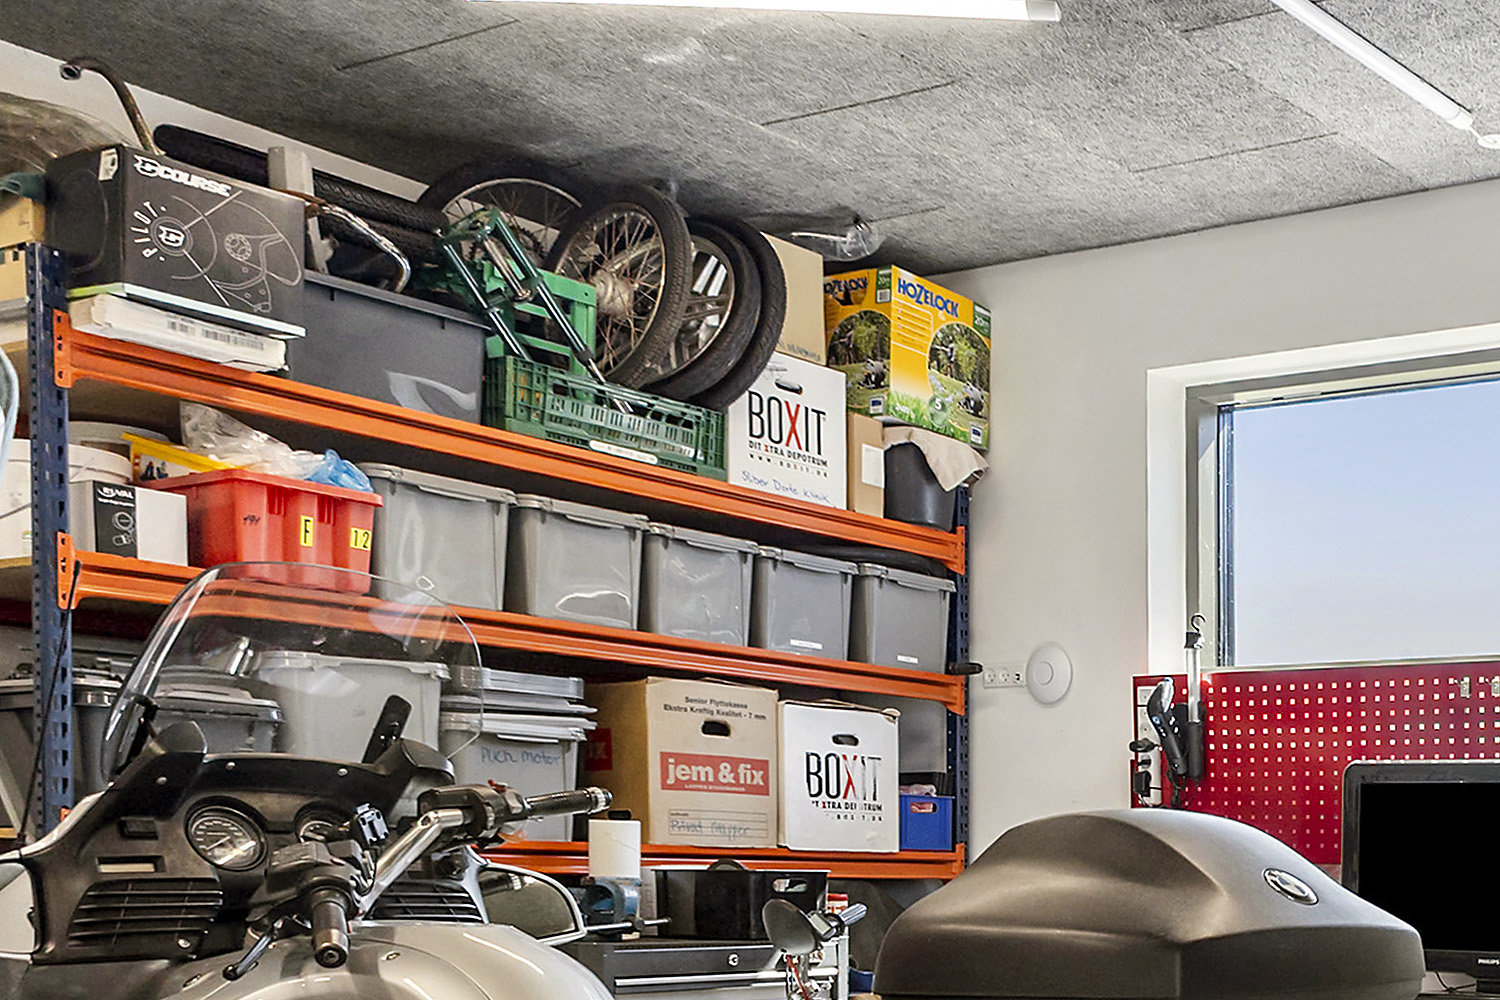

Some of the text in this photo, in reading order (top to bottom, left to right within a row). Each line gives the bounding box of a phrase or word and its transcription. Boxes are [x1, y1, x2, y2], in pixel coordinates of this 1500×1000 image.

[897, 277, 959, 318] HOZELOCK
[748, 390, 826, 455] BOXIT
[303, 519, 311, 544] F
[666, 758, 764, 785] jem & fix
[805, 752, 882, 801] BOXIT
